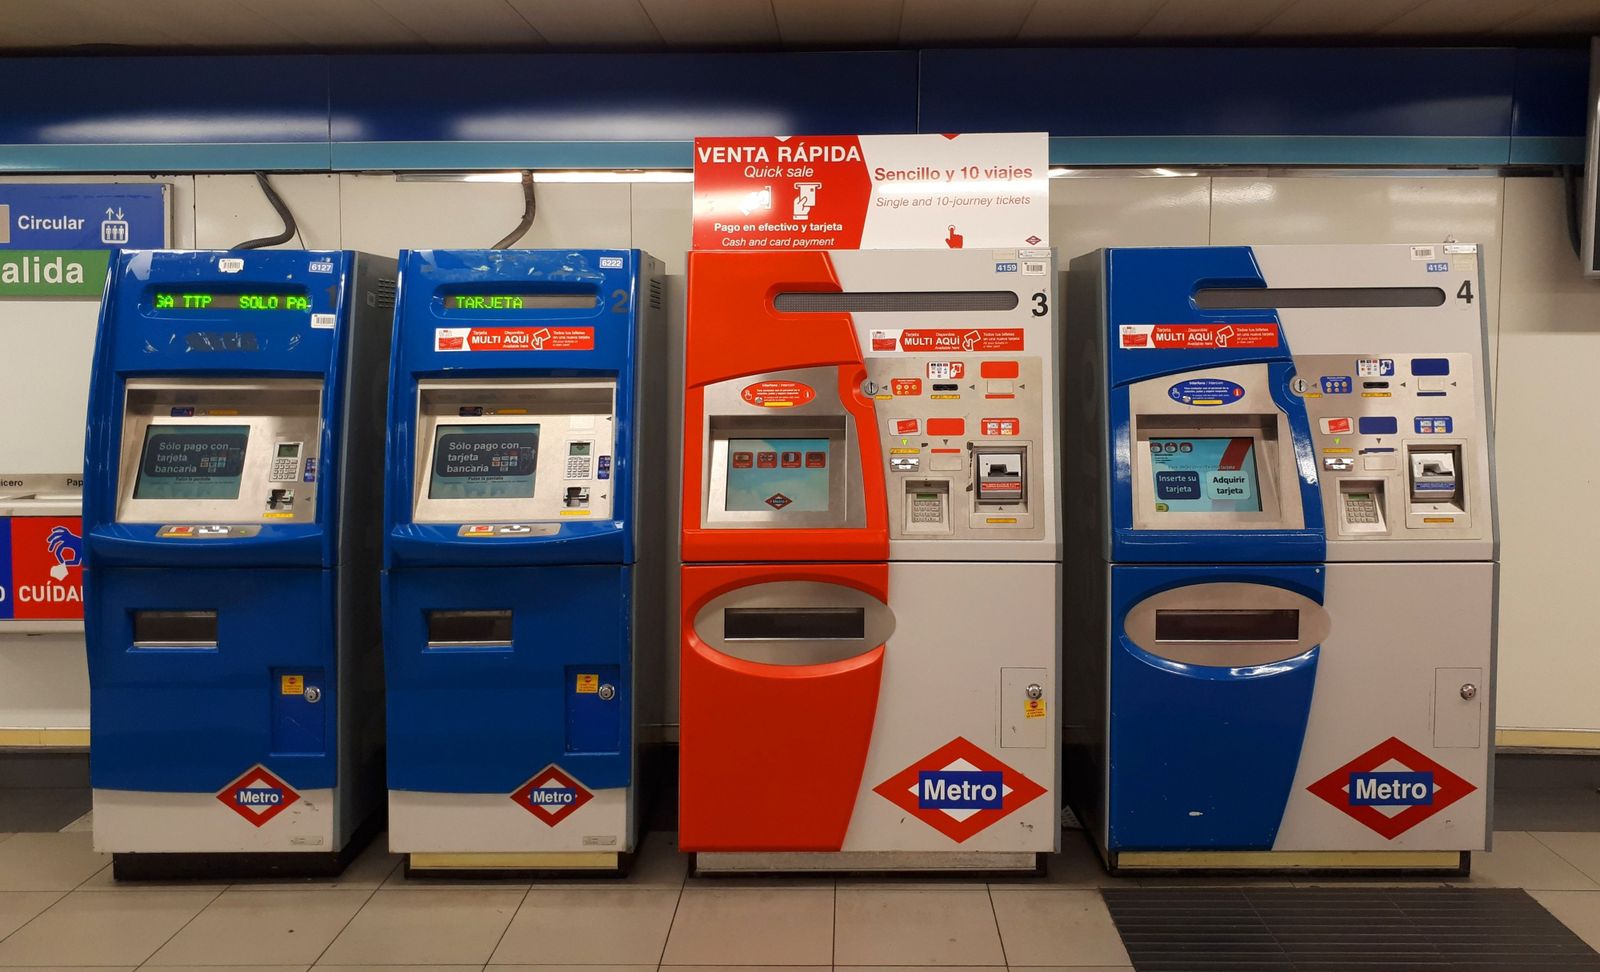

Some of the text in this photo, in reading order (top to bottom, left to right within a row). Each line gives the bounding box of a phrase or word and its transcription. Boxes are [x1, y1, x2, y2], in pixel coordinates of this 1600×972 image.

[698, 142, 861, 163] VENTA RÁPIDA
[744, 166, 814, 178] Quick sale
[874, 166, 1033, 182] Sencillo y 10 viajes
[876, 195, 1031, 209] Single and 10-journey tickets
[18, 215, 85, 230] Circular
[714, 223, 740, 233] Pago
[758, 222, 799, 231] efectivo
[801, 224, 807, 233] y
[810, 223, 843, 233] tarjeta
[722, 237, 834, 248] Cash and card payment
[311, 263, 332, 272] 6127
[602, 259, 621, 267] 6222
[1, 256, 84, 283] alida
[1456, 280, 1474, 304] 4
[183, 295, 213, 308] TTP
[239, 296, 279, 309] SOLO
[455, 296, 524, 309] TARJETA
[611, 289, 628, 313] 2
[1031, 292, 1048, 317] 3
[472, 334, 529, 344] MULTI AQUÍ
[904, 335, 960, 346] MULTI AQUÍ
[1156, 331, 1213, 341] MULTI AQUÍ
[159, 441, 181, 450] Sólo
[183, 443, 208, 452] pago
[449, 441, 471, 451] Sólo
[473, 443, 498, 452] pago
[157, 453, 187, 463] tarjeta
[448, 453, 479, 463] tarjeta
[154, 464, 197, 473] bancaria
[446, 464, 489, 473] bancaria
[0, 479, 23, 487] icero
[1212, 476, 1245, 485] Adquirir
[1165, 485, 1192, 494] tarjeta
[1216, 487, 1243, 496] tarjeta
[924, 779, 997, 801] Metro
[1356, 778, 1427, 800] Metro
[240, 790, 279, 804] Metro
[533, 789, 573, 804] Metro
